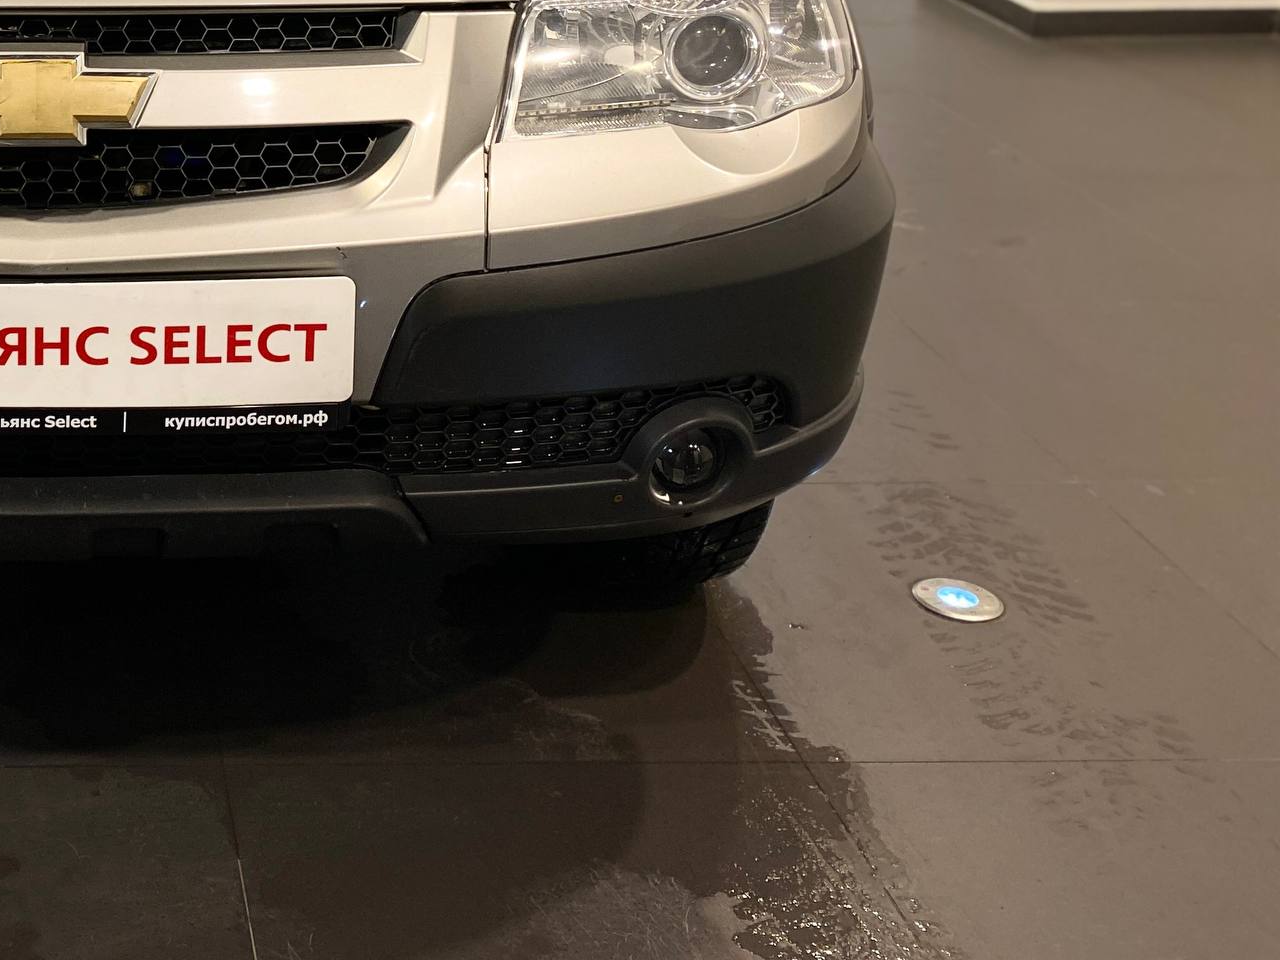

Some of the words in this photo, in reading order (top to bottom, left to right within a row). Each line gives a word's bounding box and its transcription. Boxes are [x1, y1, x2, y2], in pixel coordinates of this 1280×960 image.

[130, 322, 329, 366] SELECT
[44, 414, 98, 429] Select
[164, 409, 329, 431] куписпробегом.рф
